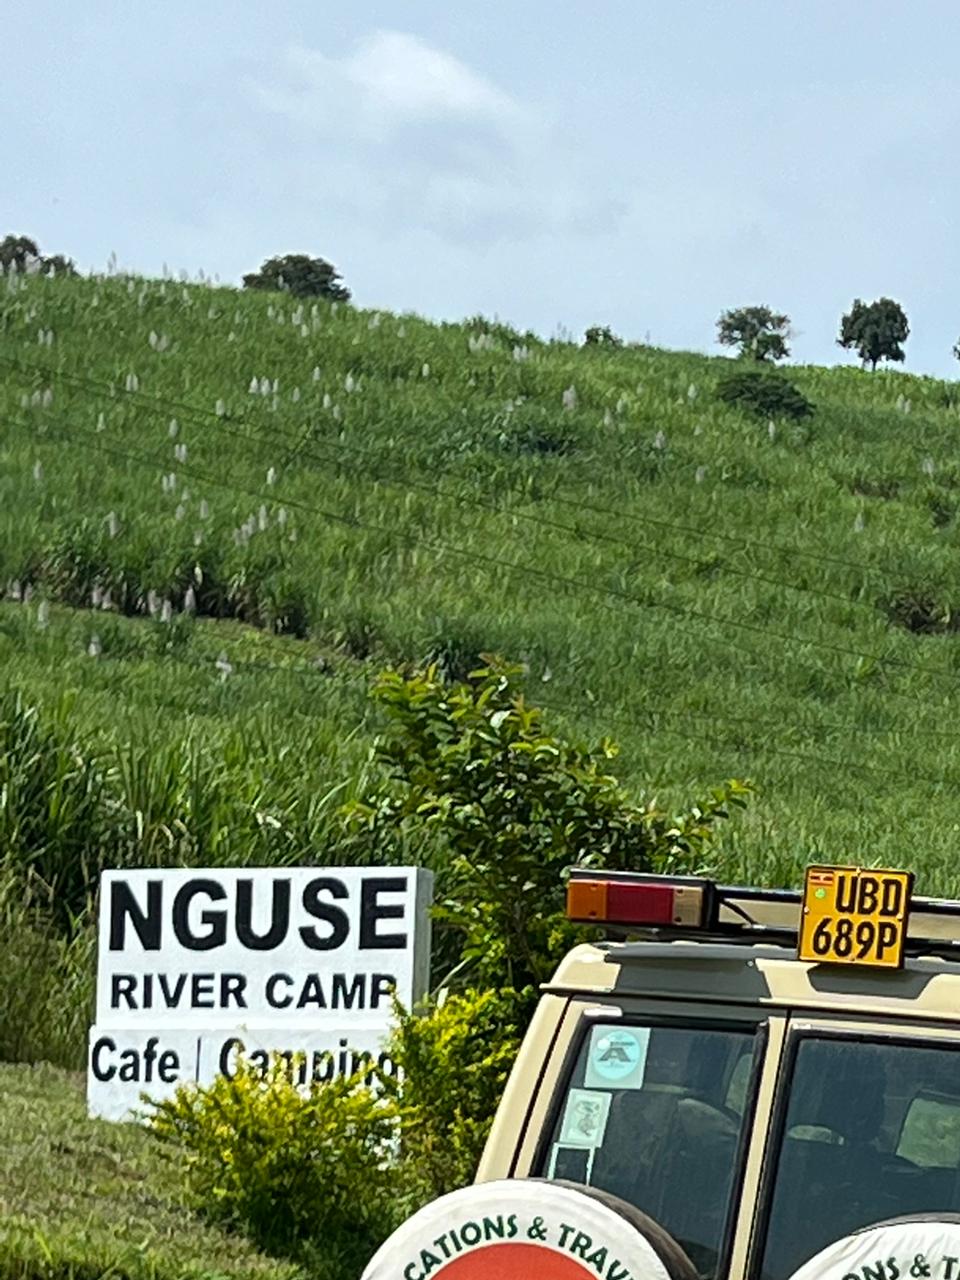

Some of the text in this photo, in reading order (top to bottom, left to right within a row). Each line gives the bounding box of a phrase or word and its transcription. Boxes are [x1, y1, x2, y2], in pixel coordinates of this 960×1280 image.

[109, 876, 408, 951] NGUSE
[835, 875, 903, 917] UBD
[813, 916, 898, 960] 689P
[110, 973, 398, 1009] RIVER CAMP
[91, 1036, 180, 1083] Cafe
[527, 1216, 548, 1241] &
[909, 1253, 931, 1278] &
